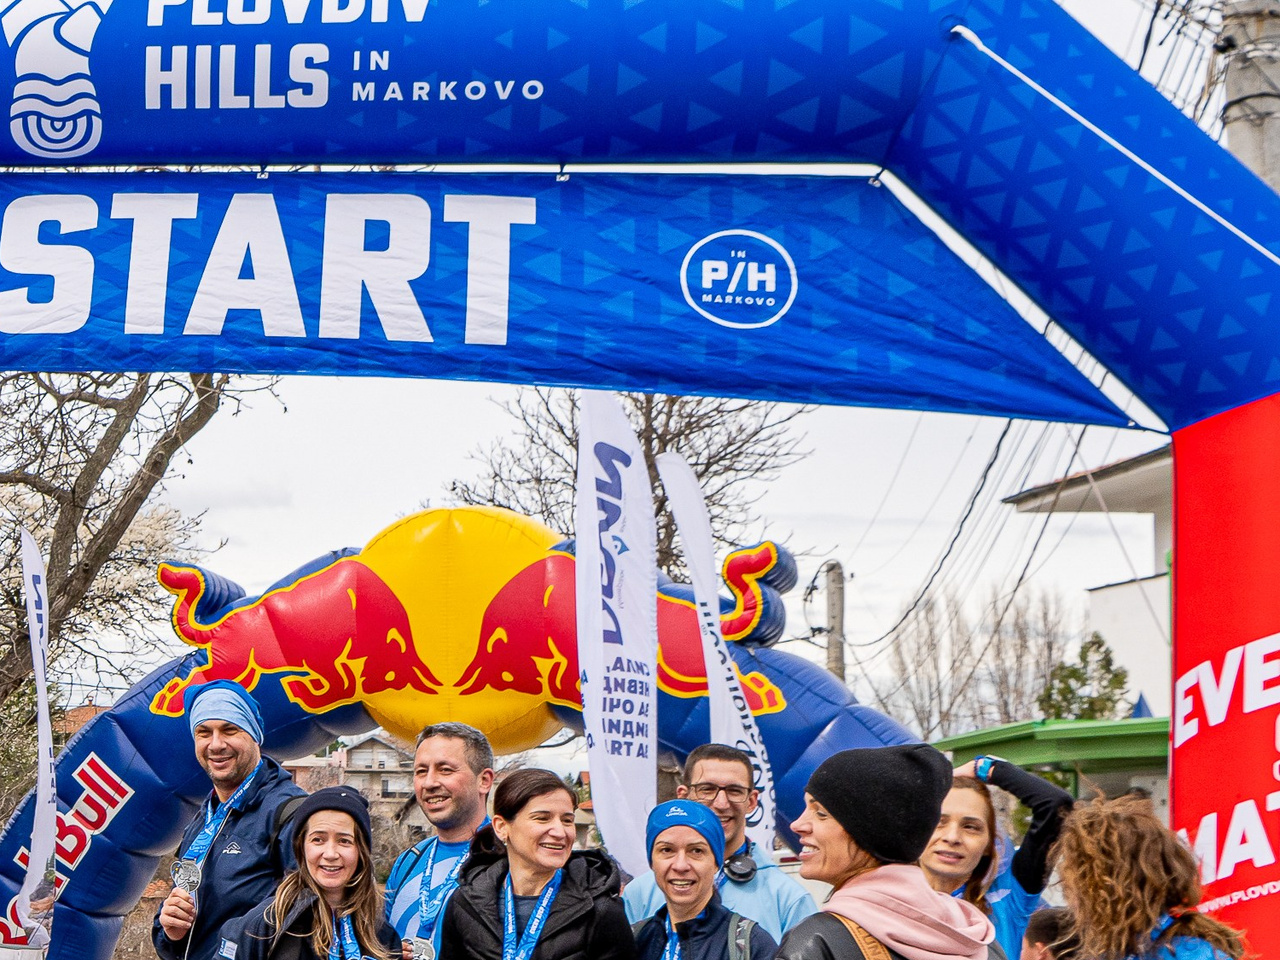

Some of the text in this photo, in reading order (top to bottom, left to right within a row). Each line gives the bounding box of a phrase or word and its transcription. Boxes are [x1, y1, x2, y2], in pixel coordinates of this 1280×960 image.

[353, 51, 389, 71] IN
[145, 43, 329, 110] HILLS
[352, 80, 544, 102] MARKOVO
[730, 250, 746, 258] IN
[702, 260, 776, 293] P/H
[702, 294, 776, 306] MARKOVO
[53, 752, 134, 870] Bull
